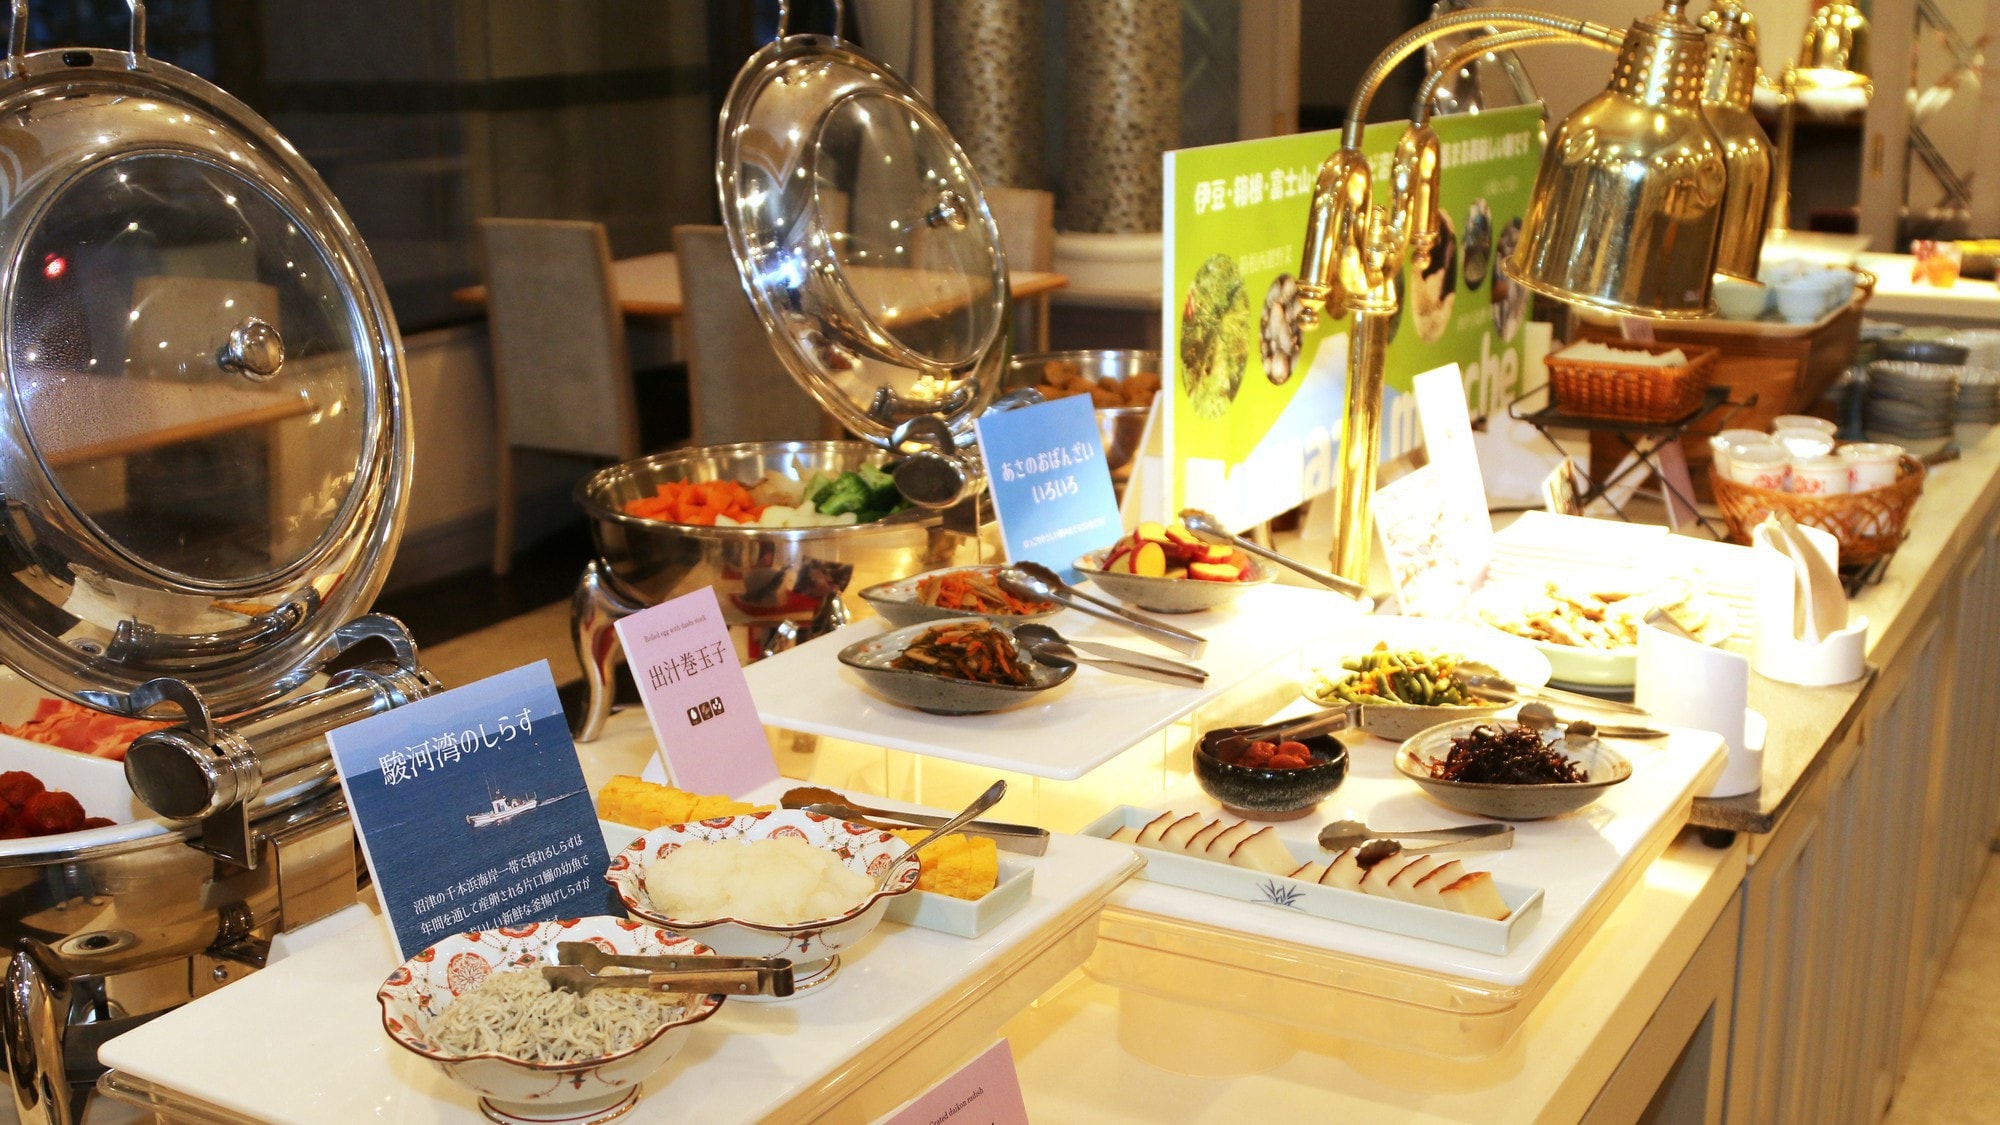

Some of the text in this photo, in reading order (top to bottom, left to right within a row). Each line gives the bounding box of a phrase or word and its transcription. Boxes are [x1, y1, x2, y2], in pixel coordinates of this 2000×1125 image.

[1002, 442, 1094, 480] あさのおばんざい
[1032, 475, 1078, 503] いろいろ
[649, 641, 726, 690] 出汁巻玉子
[379, 707, 534, 786] 駿河湾のしらす
[413, 833, 583, 915] 沼津の千本浜海岸一帯で採れるしらすは
[948, 1099, 967, 1117] daikon
[967, 1086, 984, 1104] radish
